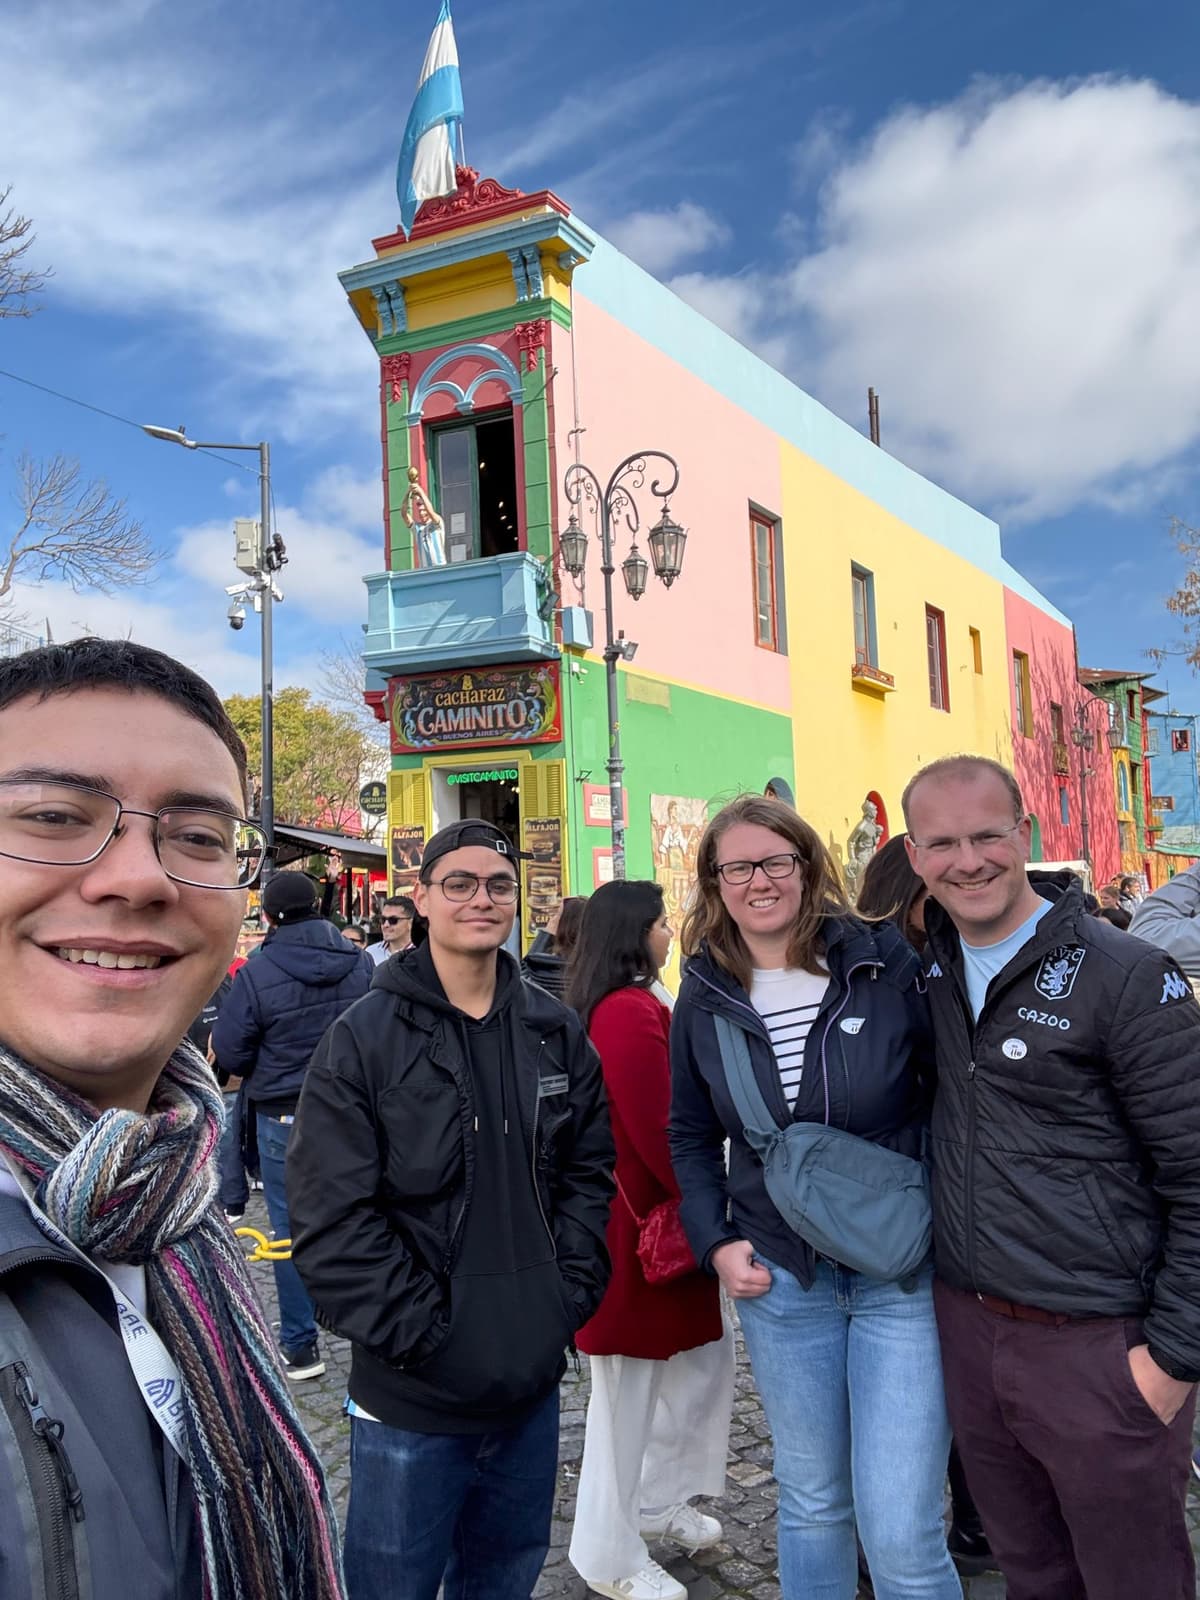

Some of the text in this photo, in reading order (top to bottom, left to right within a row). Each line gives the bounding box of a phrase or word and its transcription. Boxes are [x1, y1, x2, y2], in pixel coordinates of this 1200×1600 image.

[417, 699, 527, 736] CAMINITO
[443, 730, 500, 740] BUENOS AIRES
[447, 769, 518, 786] @VISITCAMINITO
[527, 823, 560, 832] ALFAJOR
[393, 830, 423, 840] ALFAJOR
[1018, 1007, 1071, 1030] CAZOO
